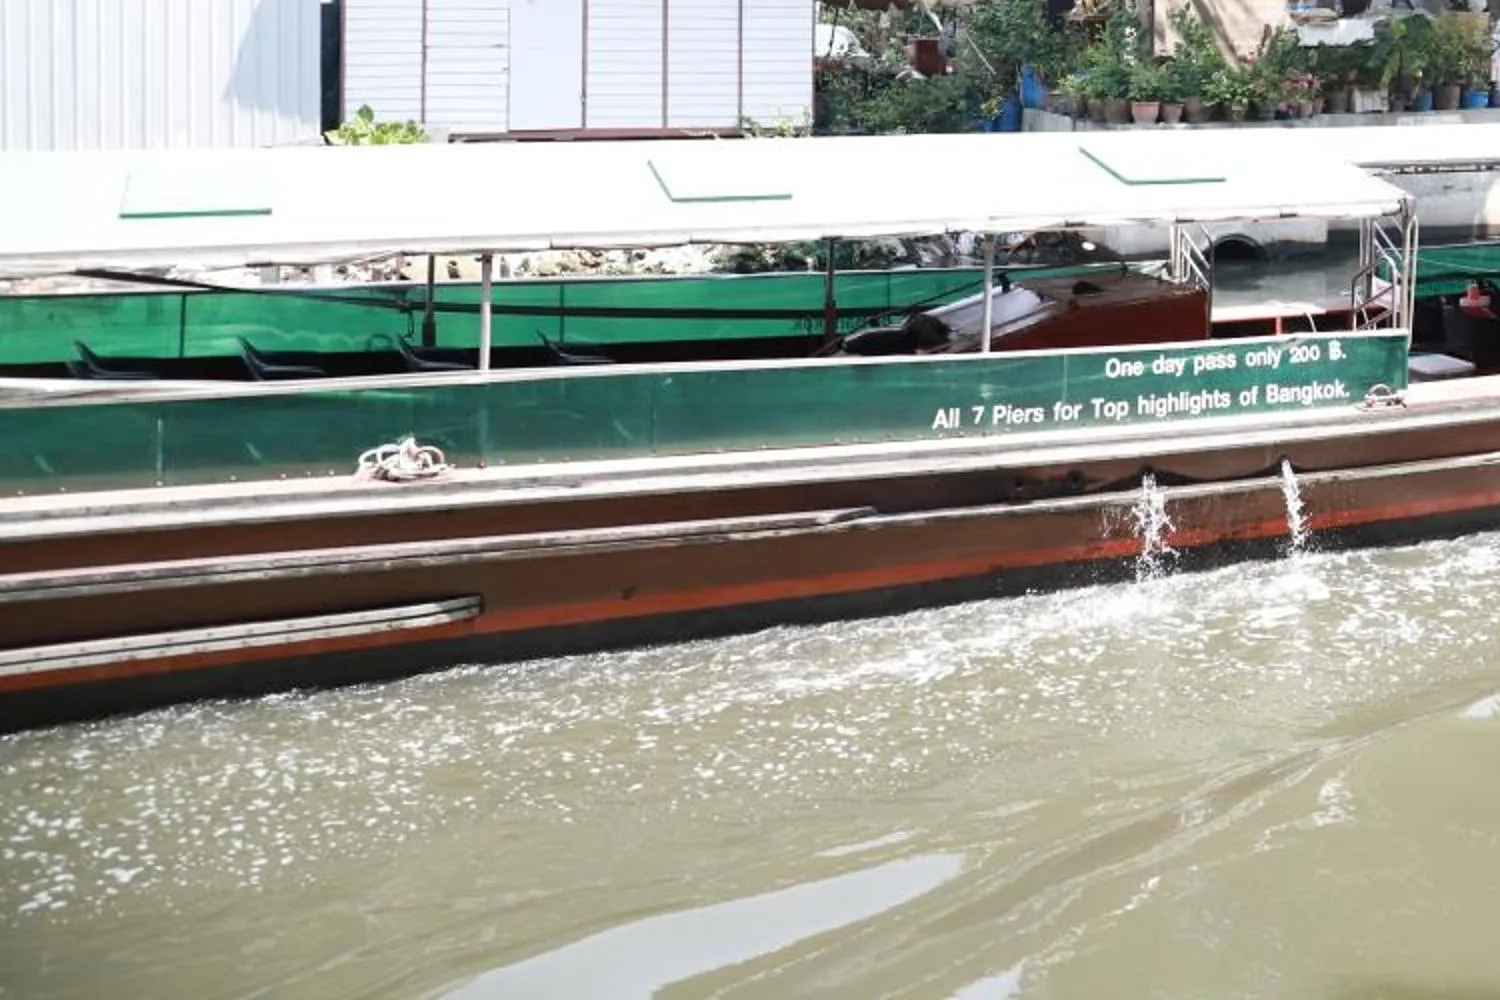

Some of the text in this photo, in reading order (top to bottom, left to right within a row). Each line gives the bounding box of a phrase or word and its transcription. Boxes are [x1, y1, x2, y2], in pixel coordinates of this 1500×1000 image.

[1104, 357, 1145, 379] One
[1151, 353, 1187, 377] day
[1192, 352, 1237, 376] pass
[1244, 345, 1283, 370] only
[1288, 344, 1321, 364] 200
[931, 378, 1351, 430] All 7 Piers for Top highlights of Bangkok.
